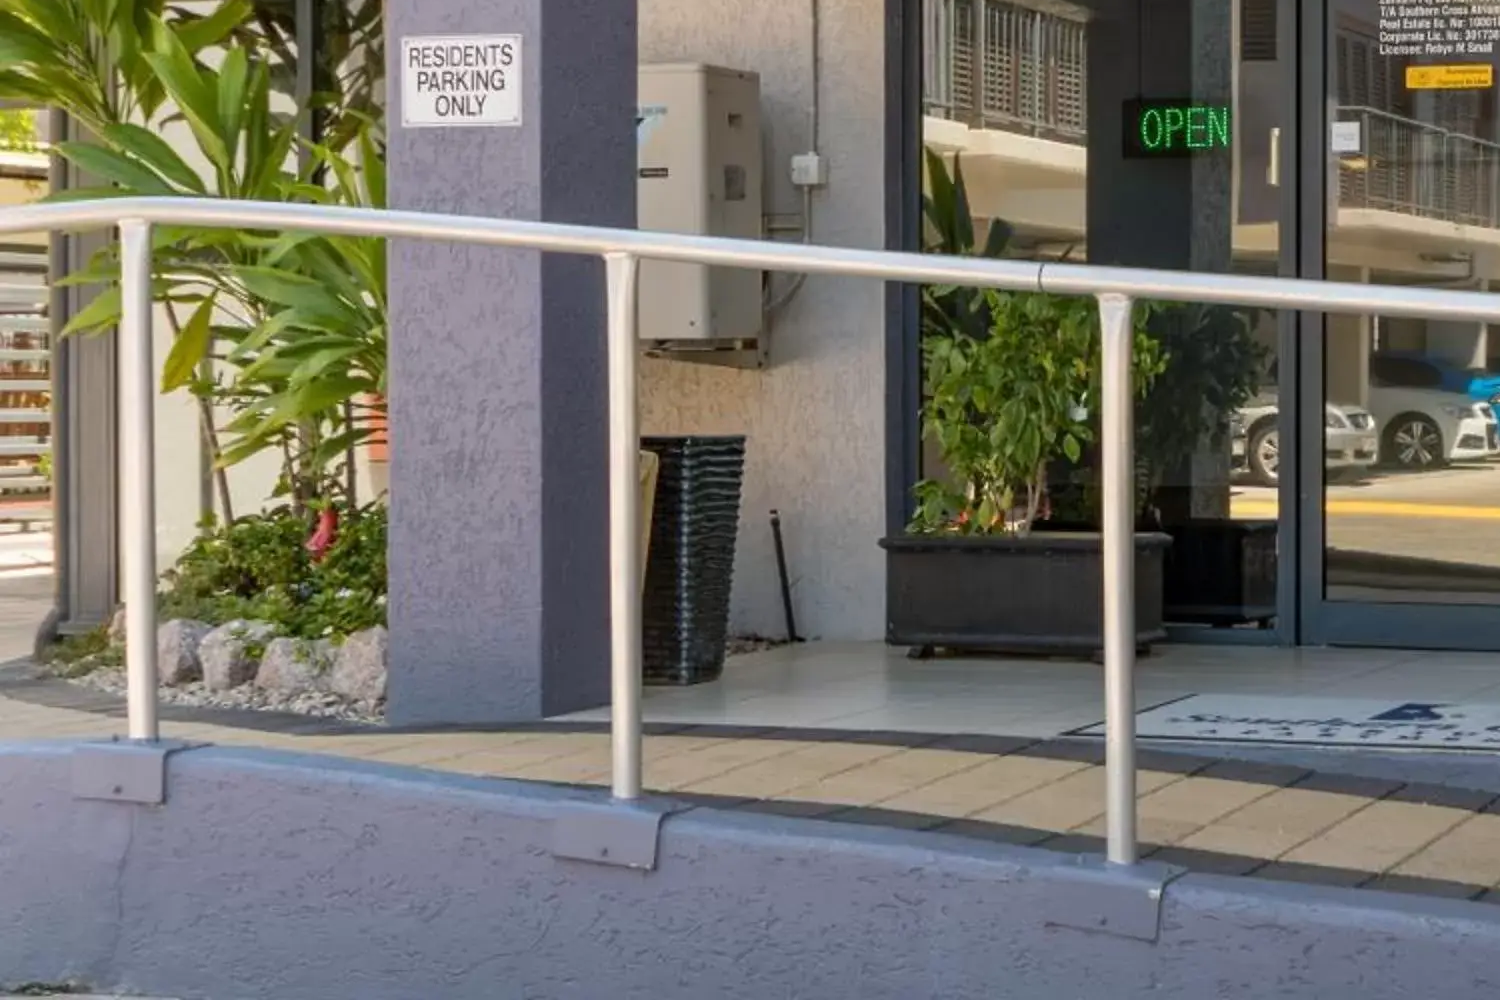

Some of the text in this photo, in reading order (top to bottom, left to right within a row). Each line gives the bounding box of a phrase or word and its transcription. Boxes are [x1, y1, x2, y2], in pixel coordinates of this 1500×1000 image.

[409, 43, 513, 68] RESIDENTS
[417, 69, 506, 92] PARKING
[435, 94, 487, 117] ONLY
[1142, 106, 1228, 149] OPEN
